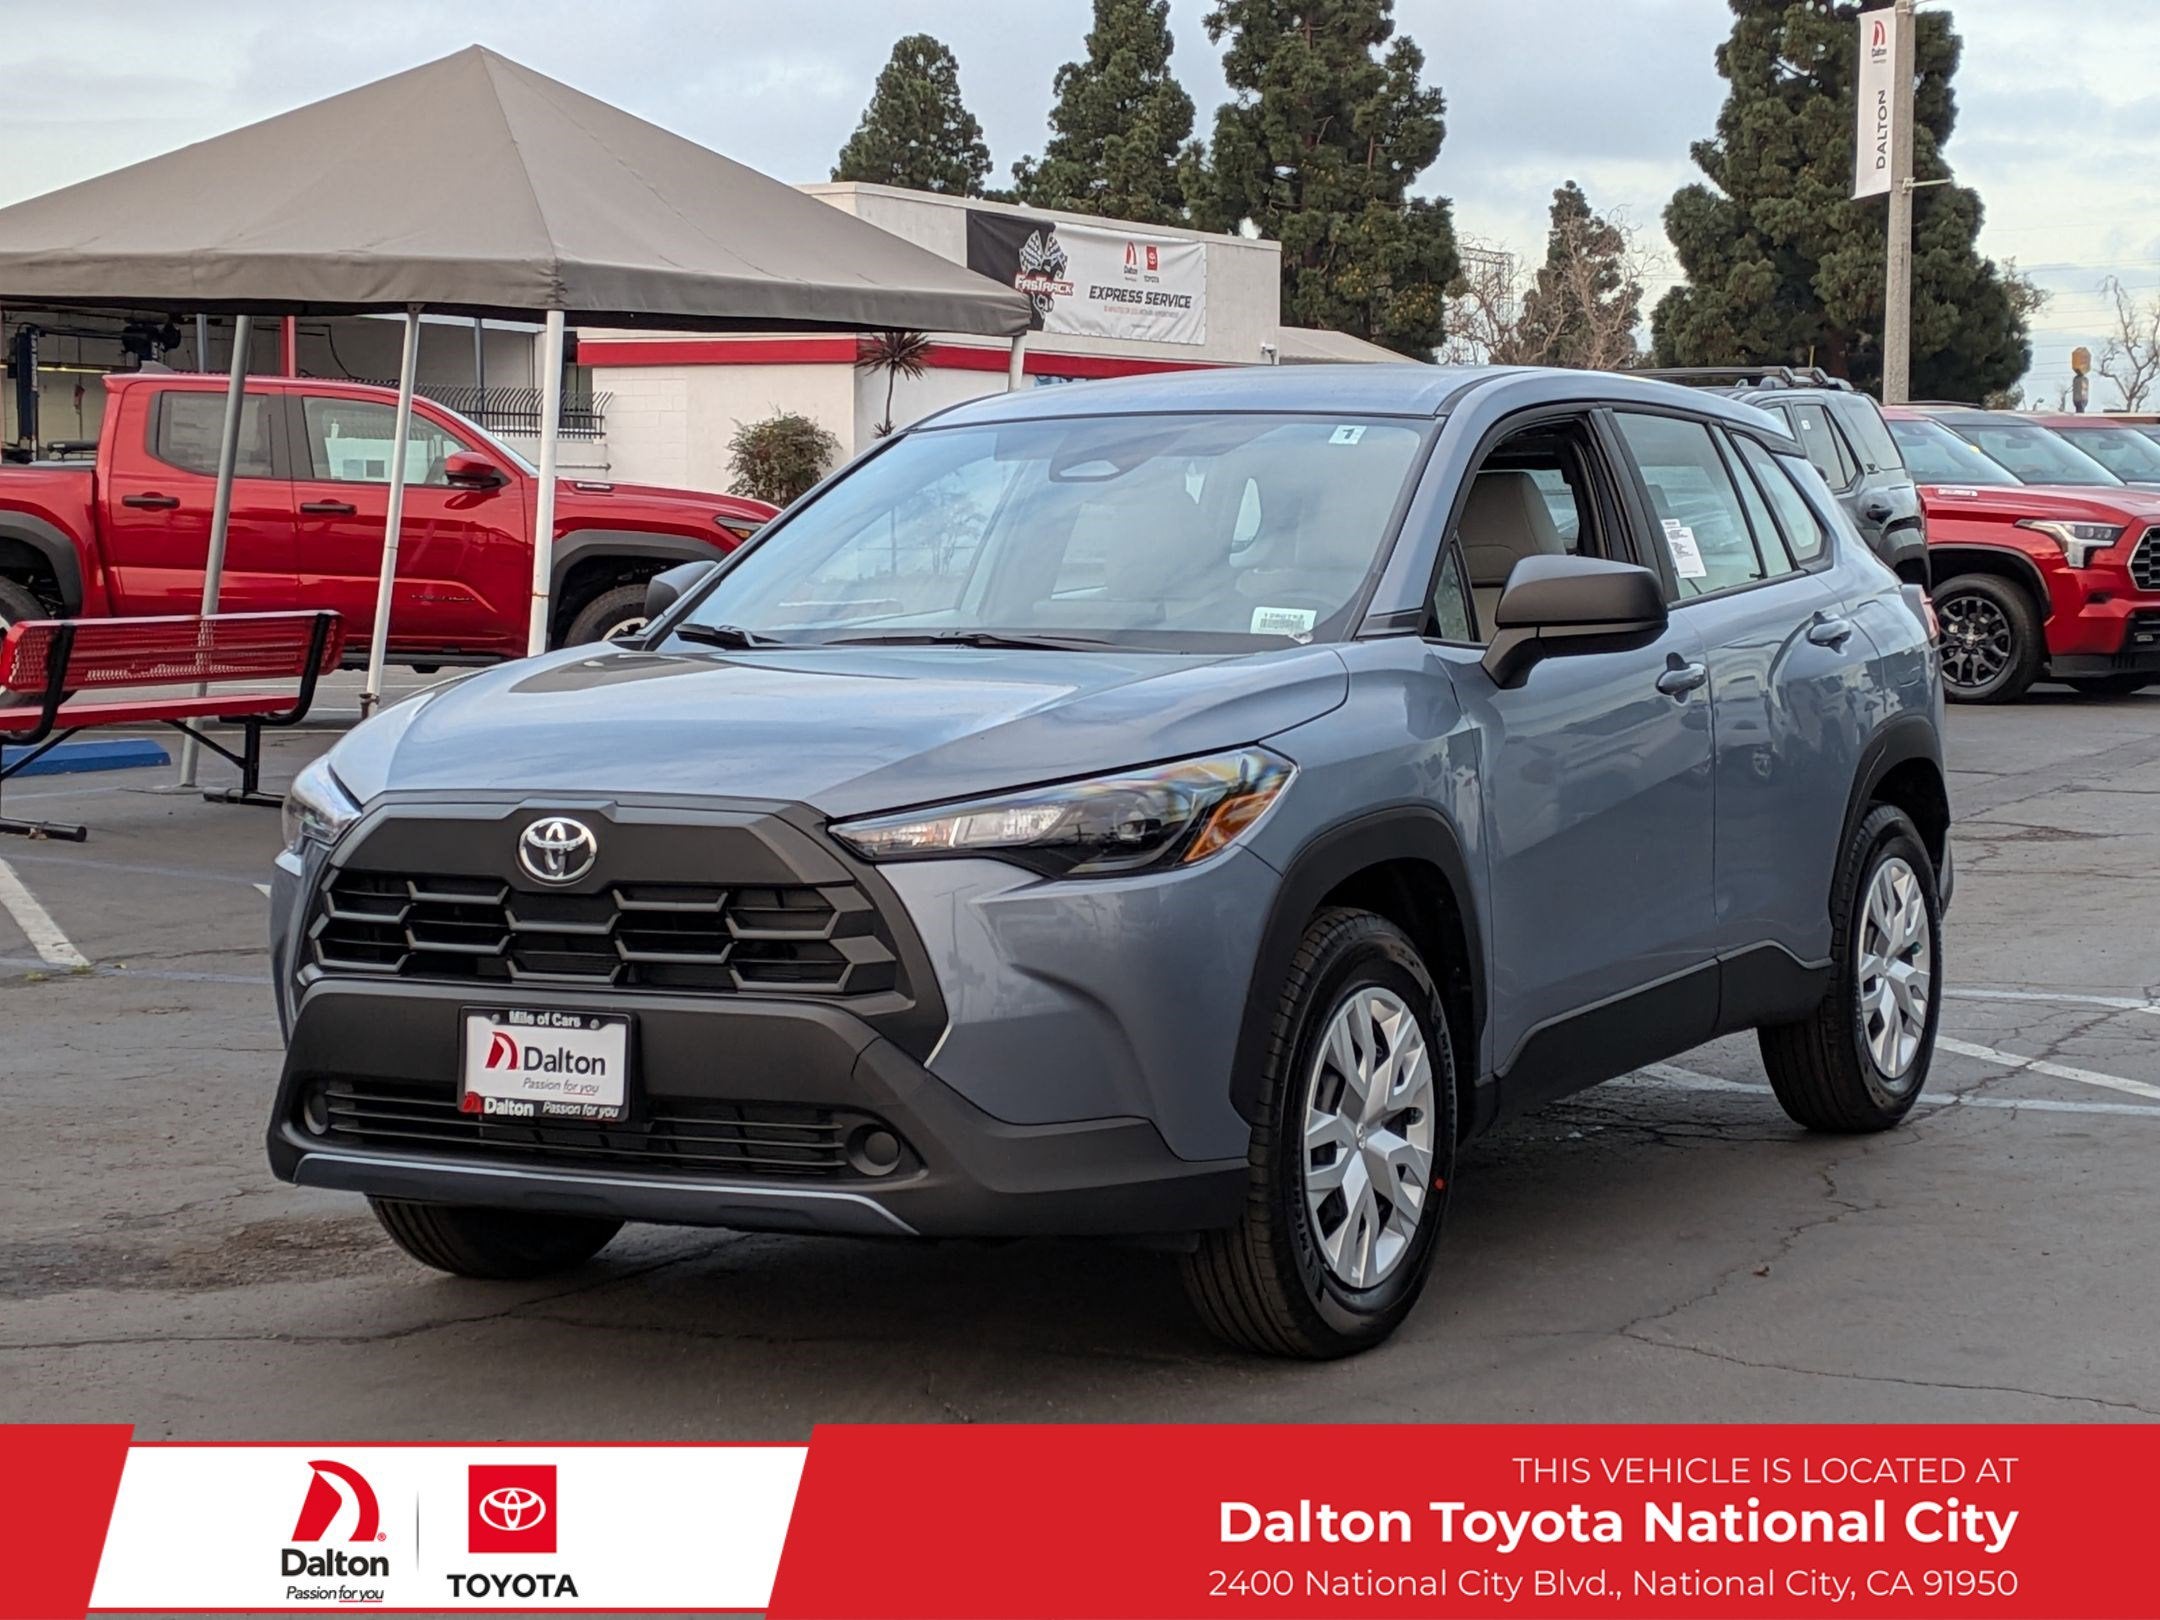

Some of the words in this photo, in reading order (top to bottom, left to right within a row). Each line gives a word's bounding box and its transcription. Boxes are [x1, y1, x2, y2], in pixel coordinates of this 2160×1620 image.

[1875, 89, 1888, 170] DALTON
[1089, 285, 1144, 304] EXPRESS
[1144, 291, 1192, 309] SERVICE
[509, 1010, 535, 1025] Mile
[537, 1012, 550, 1025] of
[552, 1014, 582, 1028] Cars
[523, 1046, 606, 1076] Dalton
[523, 1077, 560, 1090] Passion
[563, 1079, 578, 1093] for
[579, 1084, 600, 1094] you
[484, 1098, 534, 1116] Dalton
[543, 1101, 581, 1115] Passion
[582, 1104, 598, 1116] for
[599, 1107, 619, 1119] you
